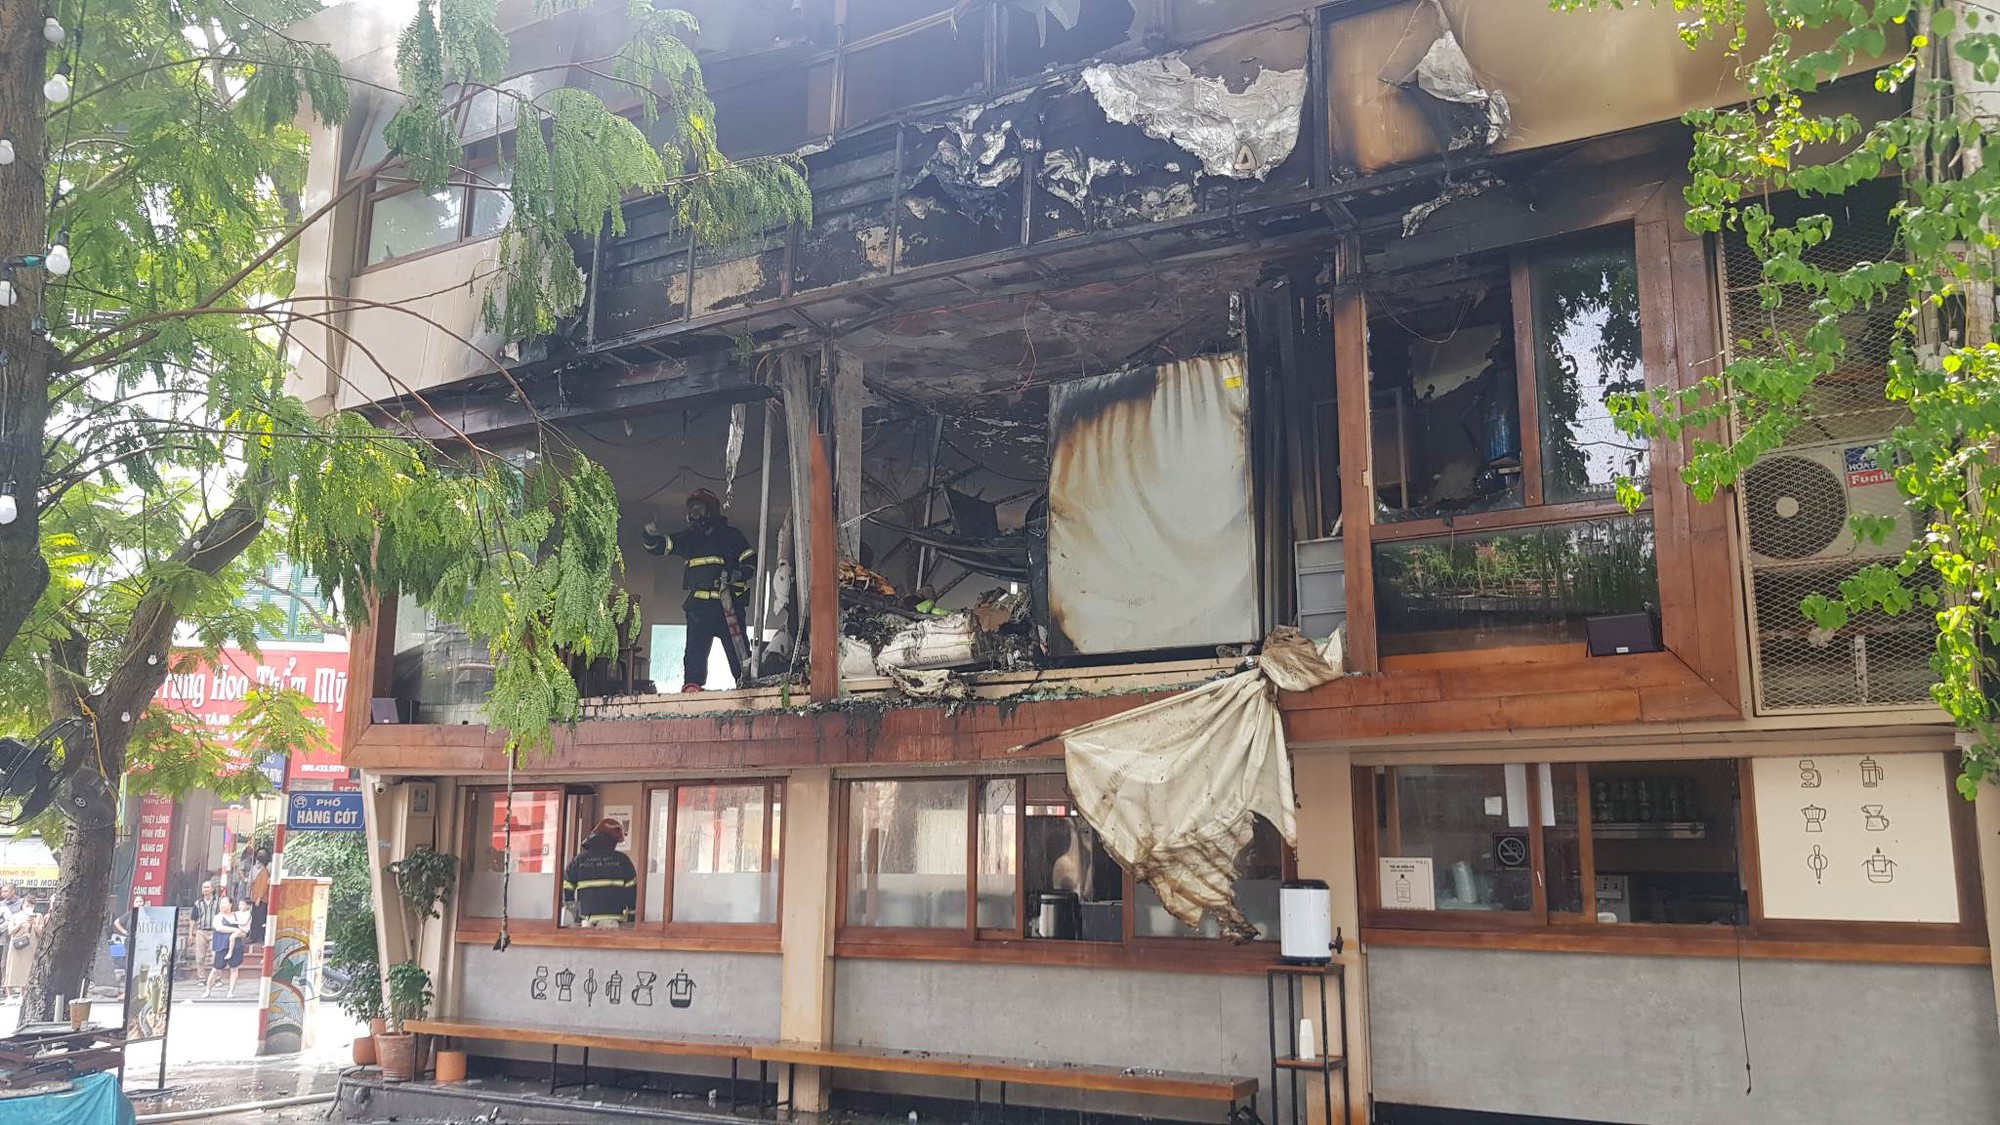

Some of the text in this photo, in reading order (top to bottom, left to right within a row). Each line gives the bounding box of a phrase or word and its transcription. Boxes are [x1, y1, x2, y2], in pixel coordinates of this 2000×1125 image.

[1851, 473, 1892, 484] Funik
[153, 671, 207, 708] rung
[313, 666, 348, 713] Mỹ
[316, 796, 342, 807] PHỐ
[297, 807, 358, 824] HÀNG CÓT
[138, 921, 172, 934] MATCHA
